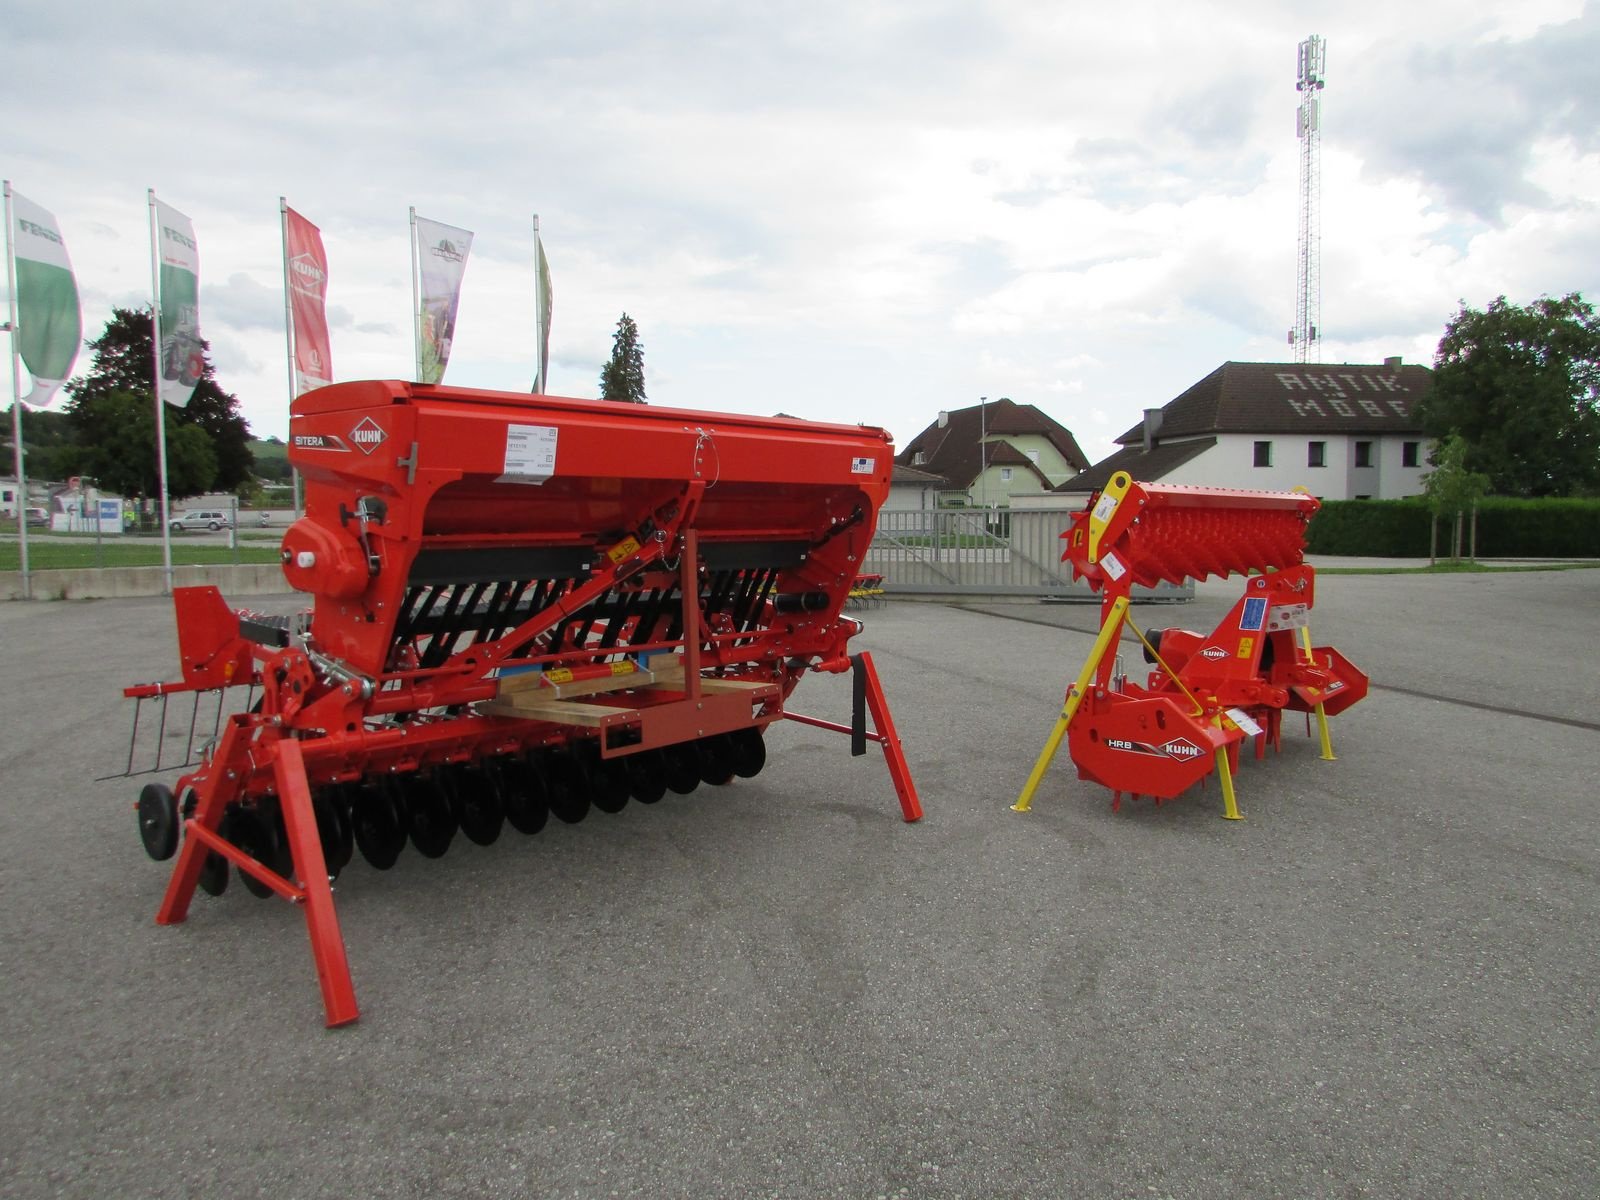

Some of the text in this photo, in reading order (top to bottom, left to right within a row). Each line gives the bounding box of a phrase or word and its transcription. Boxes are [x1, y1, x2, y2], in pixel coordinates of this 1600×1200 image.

[292, 260, 321, 280] KUHN
[295, 436, 324, 447] SITERA
[354, 429, 382, 443] KUHN
[1203, 650, 1226, 658] KUHN
[1108, 739, 1132, 749] HRB
[1165, 744, 1198, 756] KUHN
